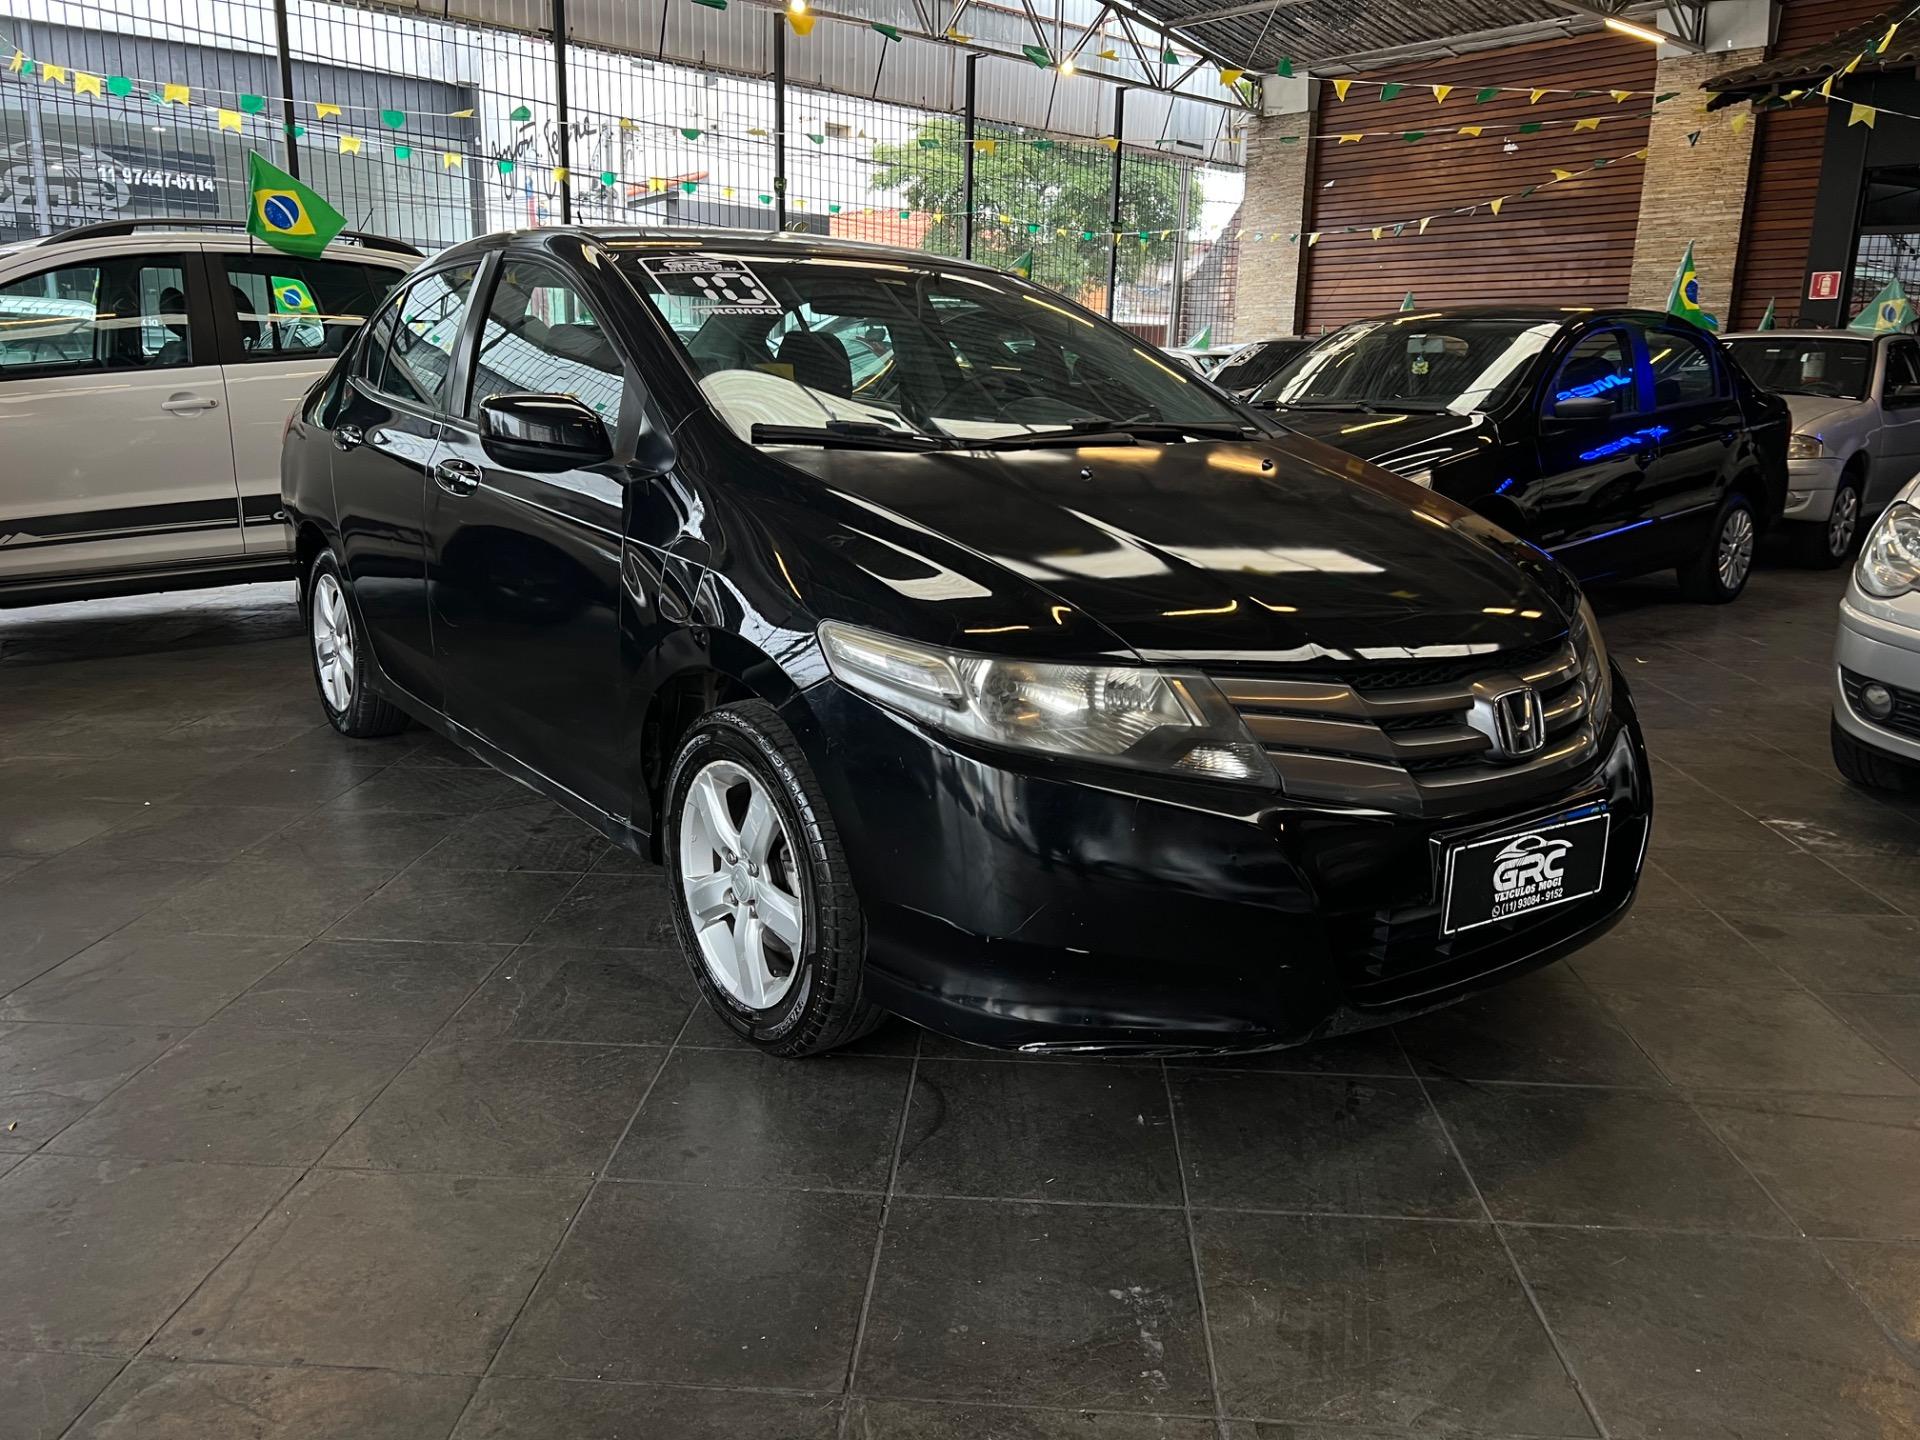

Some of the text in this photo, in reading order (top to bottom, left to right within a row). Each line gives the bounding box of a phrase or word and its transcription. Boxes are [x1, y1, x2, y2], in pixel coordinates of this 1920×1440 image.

[122, 167, 216, 193] 97447-6114
[692, 273, 768, 305] 10
[1493, 847, 1567, 892] GRC
[1494, 876, 1562, 903] VEICULOS MOGI
[1501, 900, 1517, 915] (11)
